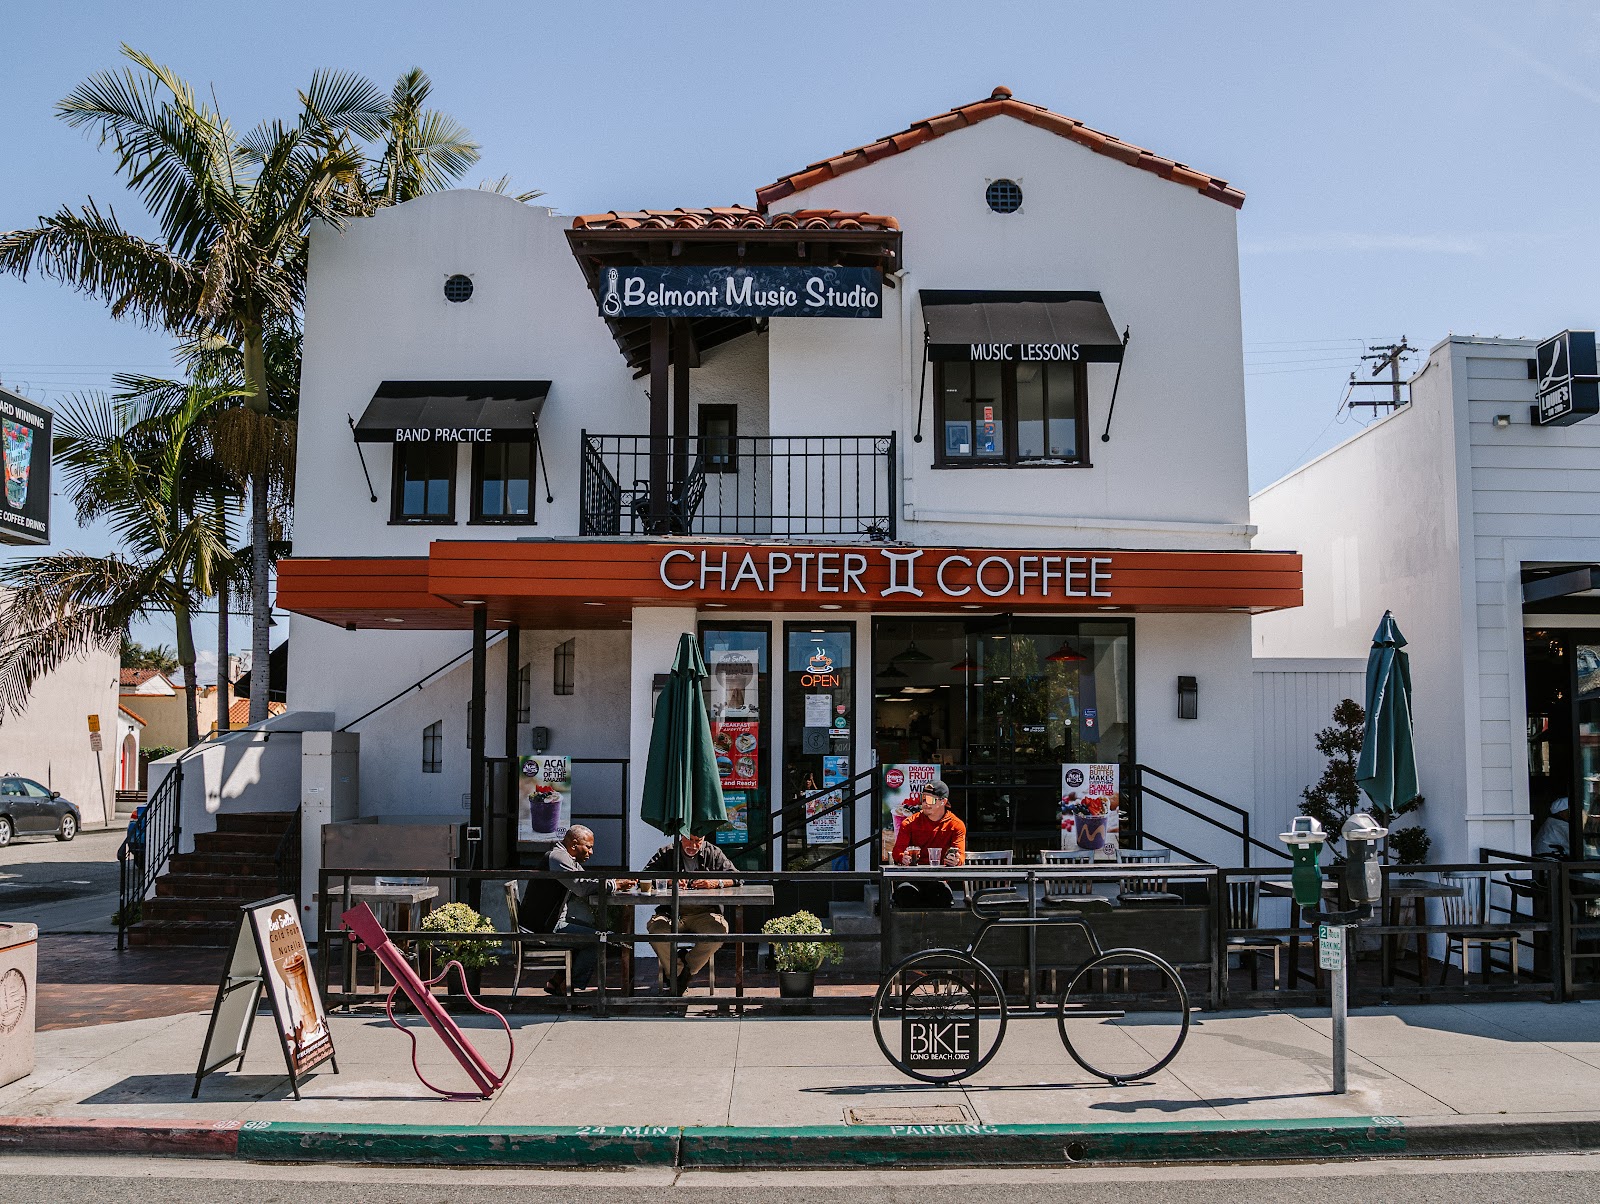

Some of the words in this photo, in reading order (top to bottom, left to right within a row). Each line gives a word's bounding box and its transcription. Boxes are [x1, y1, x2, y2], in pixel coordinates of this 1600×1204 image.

[624, 277, 718, 306] Belmont
[726, 276, 797, 307] Music
[805, 277, 879, 308] Studio
[970, 343, 1013, 361] MUSIC
[1020, 343, 1080, 361] LESSONS
[15, 405, 44, 430] WINNING
[396, 428, 431, 442] BAND
[435, 428, 492, 442] PRACTICE
[3, 513, 25, 528] COFFEE
[25, 517, 46, 532] DRINKS
[659, 549, 867, 593] CHAPTER
[936, 555, 1113, 597] COFFEE
[801, 674, 839, 687] OPEN
[909, 772, 935, 780] FRUIT
[270, 931, 285, 943] Cold
[1321, 928, 1327, 938] 2
[278, 940, 301, 956] Nutella
[1321, 941, 1340, 950] PARKING
[910, 1023, 970, 1053] BIKE
[575, 1126, 606, 1135] 24
[622, 1126, 668, 1135] MIN
[890, 1125, 998, 1135] PARKING
